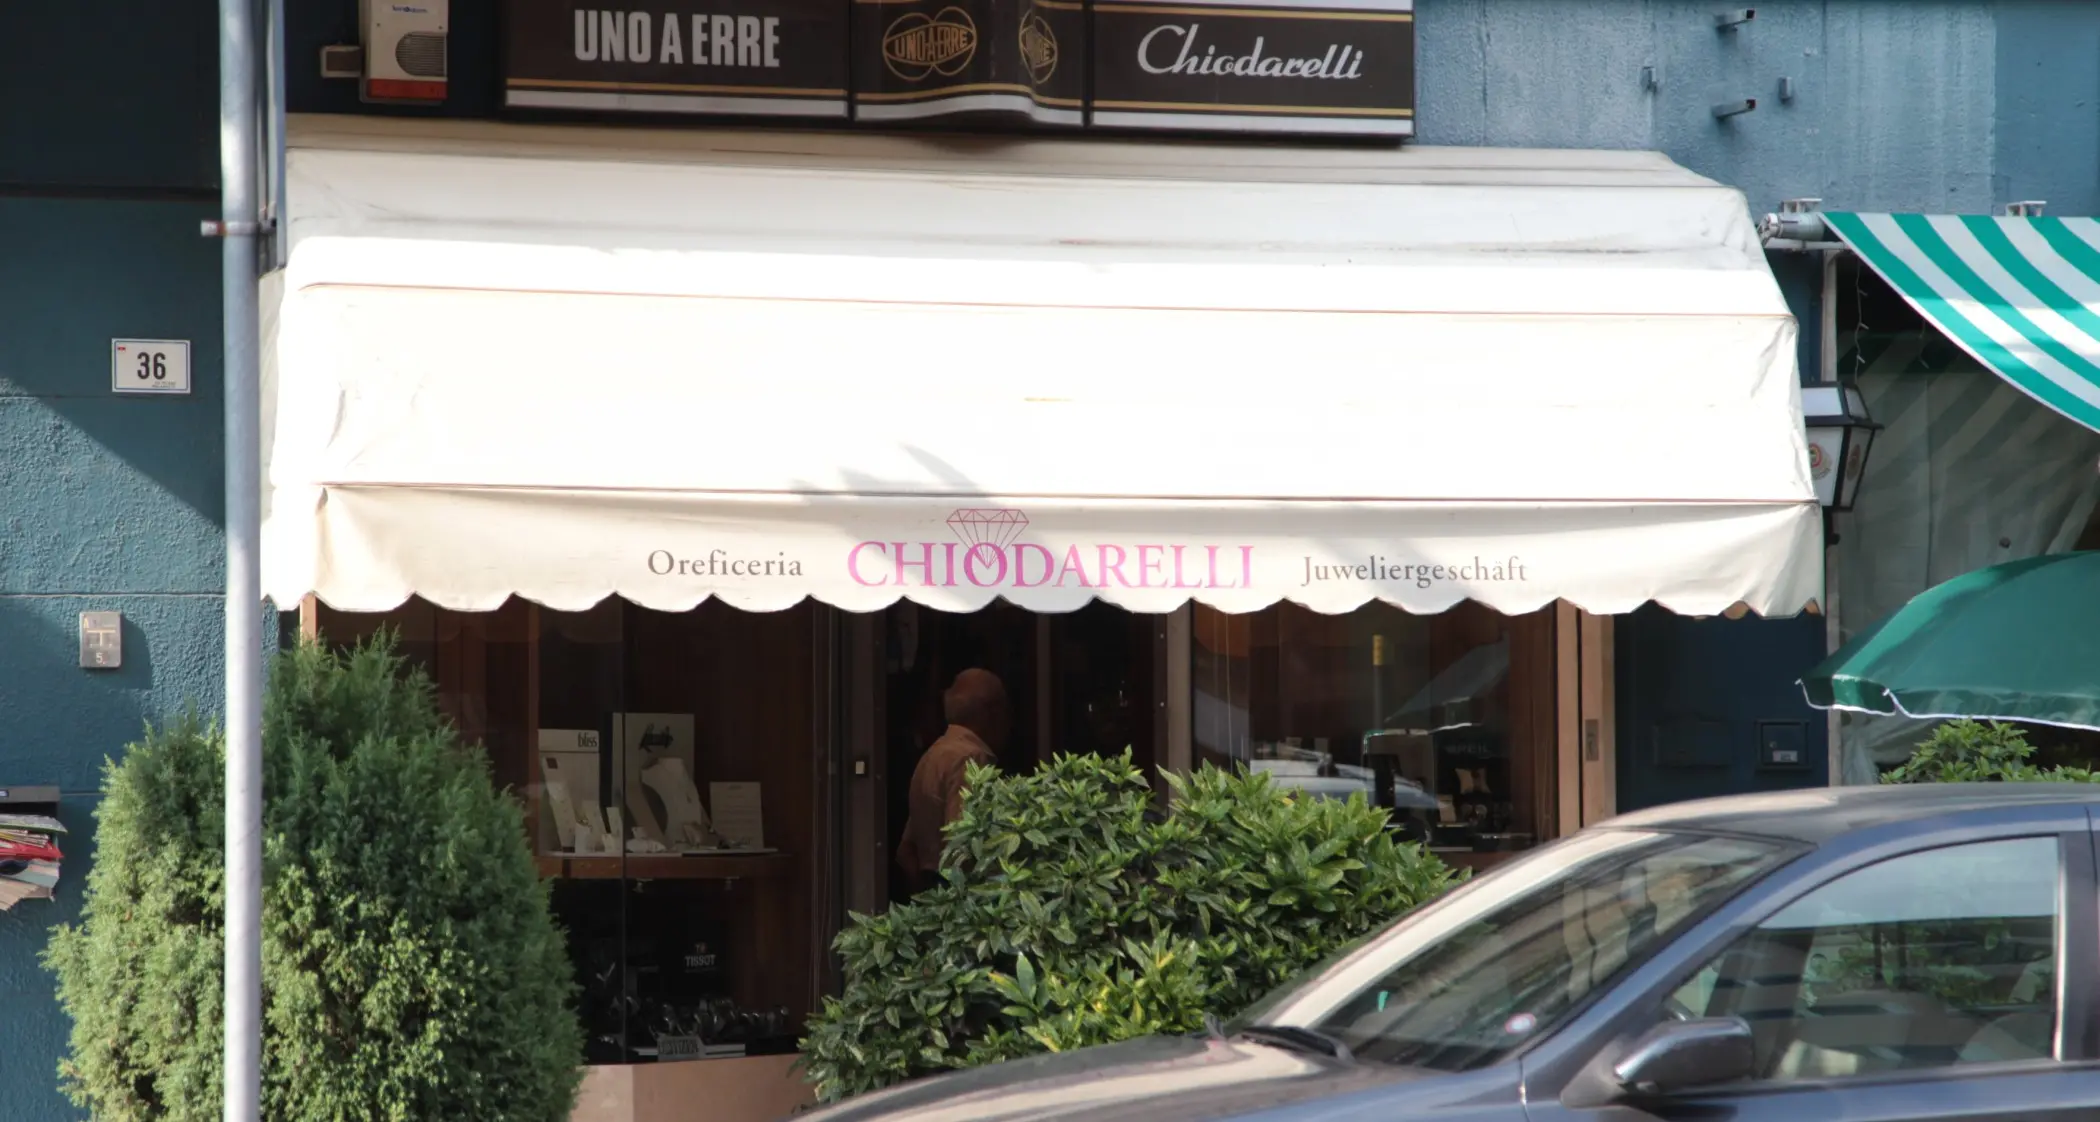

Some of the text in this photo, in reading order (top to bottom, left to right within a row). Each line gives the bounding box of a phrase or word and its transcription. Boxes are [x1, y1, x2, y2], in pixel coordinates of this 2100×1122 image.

[574, 9, 780, 67] UNO A ERRE
[1137, 23, 1363, 79] Chiodarelli
[137, 352, 166, 380] 36
[647, 541, 1528, 589] Oreficeria CHIODARELLI Juweliergeschäft
[95, 652, 103, 664] 5
[577, 732, 598, 748] bliss
[684, 954, 717, 968] TISSOT
